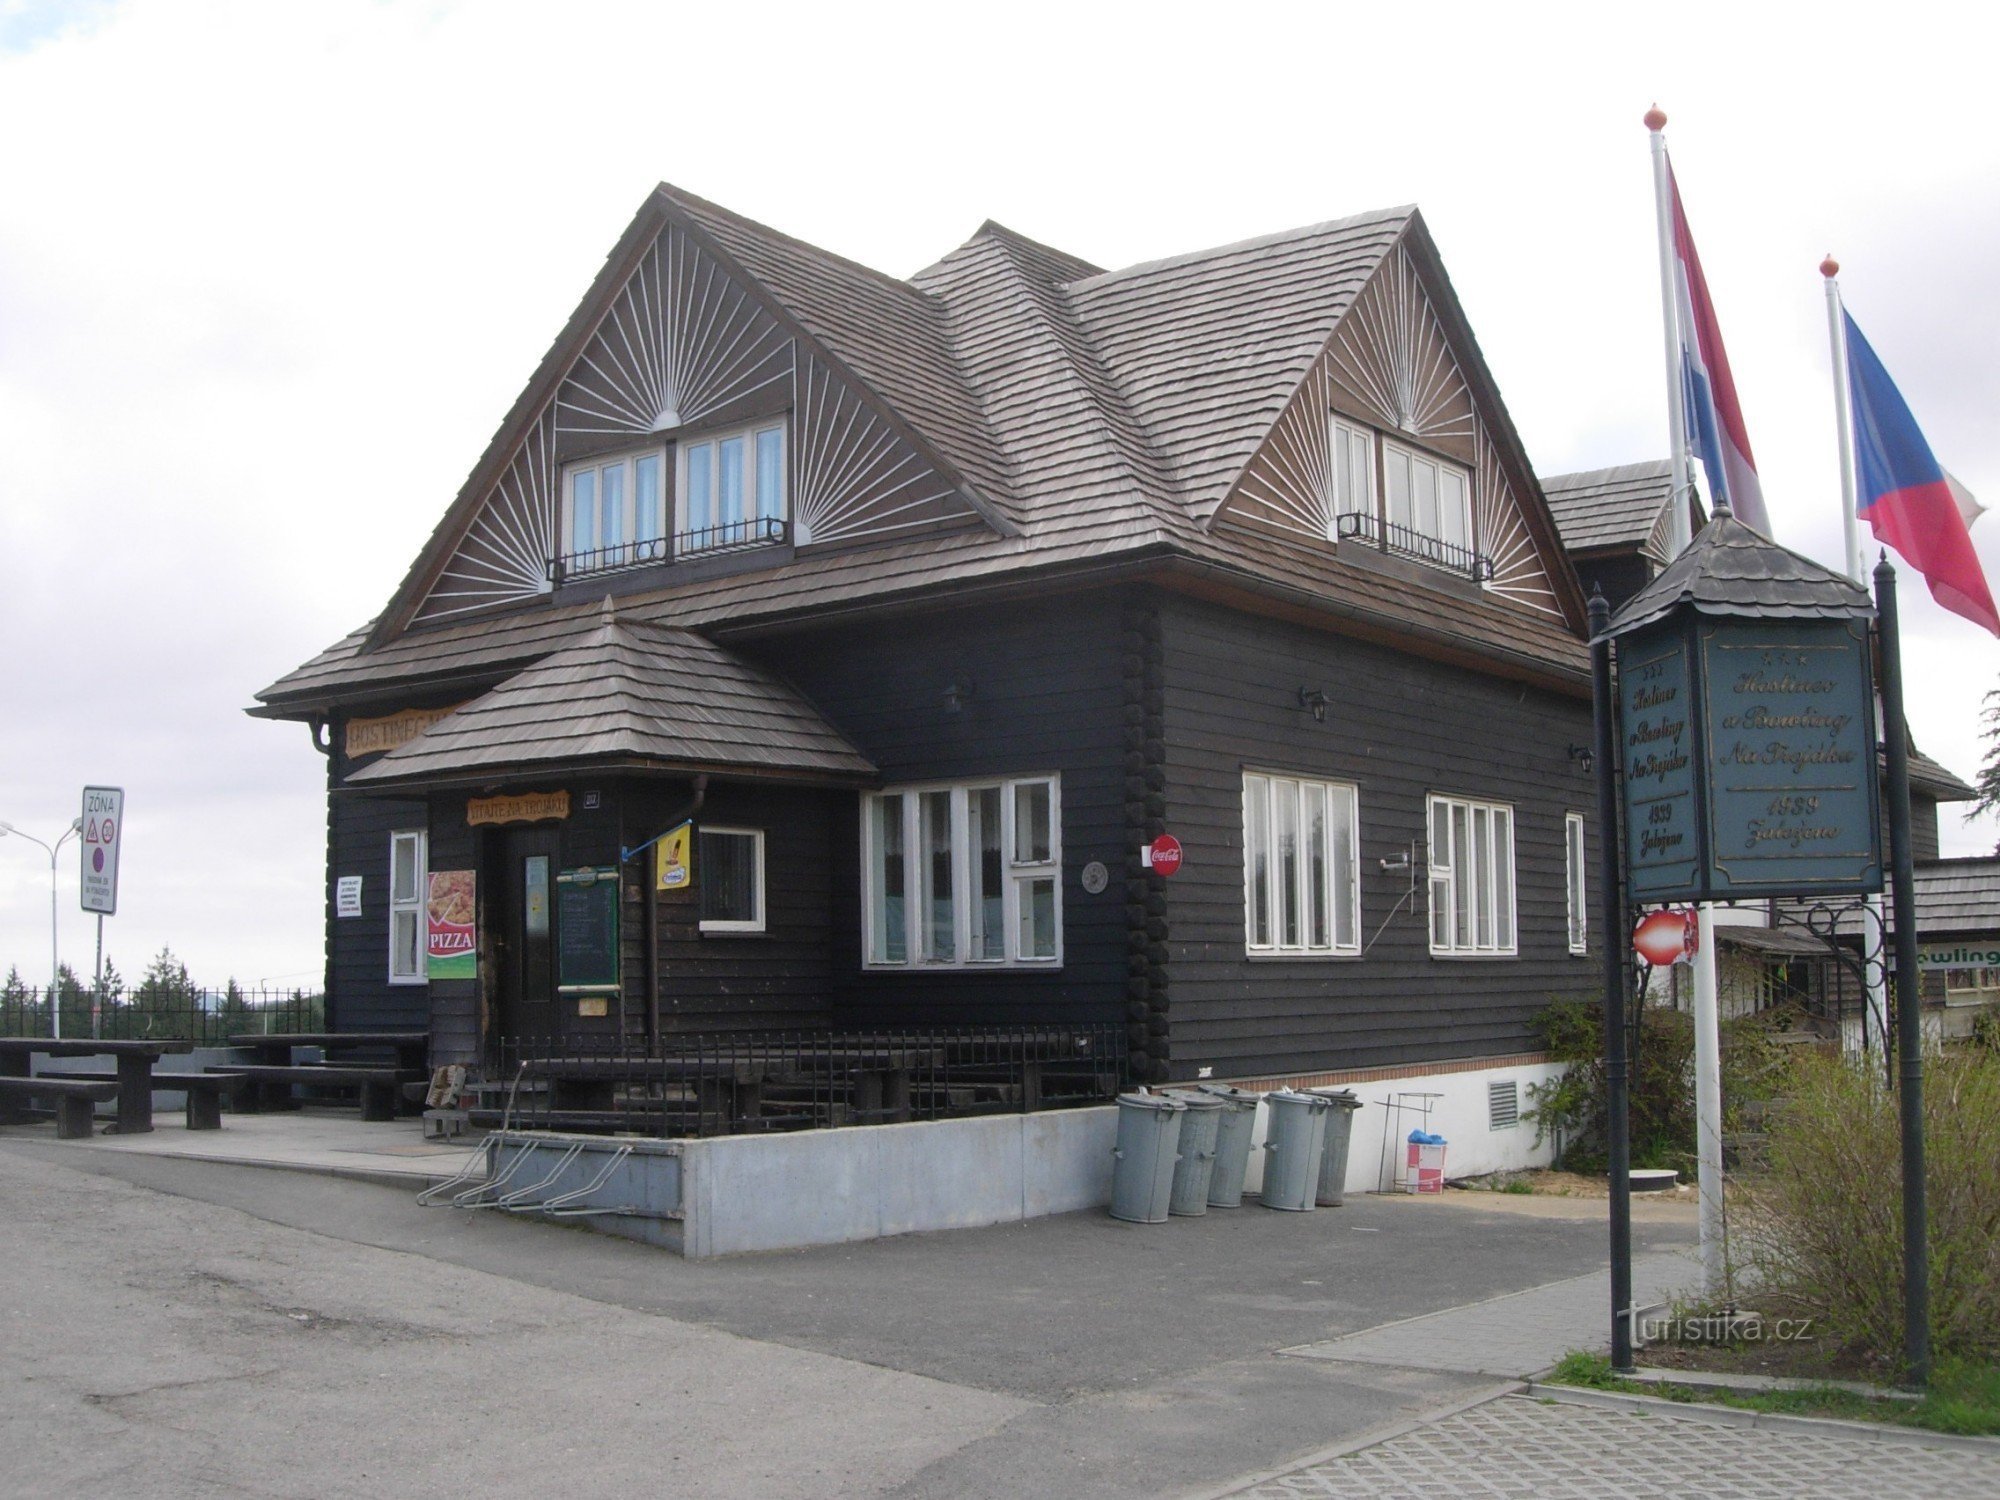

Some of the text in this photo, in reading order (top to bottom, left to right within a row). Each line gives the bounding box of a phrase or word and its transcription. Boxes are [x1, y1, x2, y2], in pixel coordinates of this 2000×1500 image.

[1732, 670, 1838, 694] Hostinec
[1637, 716, 1685, 745] Bowling
[1722, 705, 1852, 737] a Bowling
[1720, 741, 1758, 765] Na
[1629, 757, 1647, 780] Na
[88, 793, 114, 813] ZÓNA
[1648, 803, 1672, 825] 1939
[1768, 795, 1819, 816] 1939
[1151, 848, 1180, 862] Coca-Cola
[430, 932, 473, 949] PIZZA
[1917, 948, 2000, 965] owling
